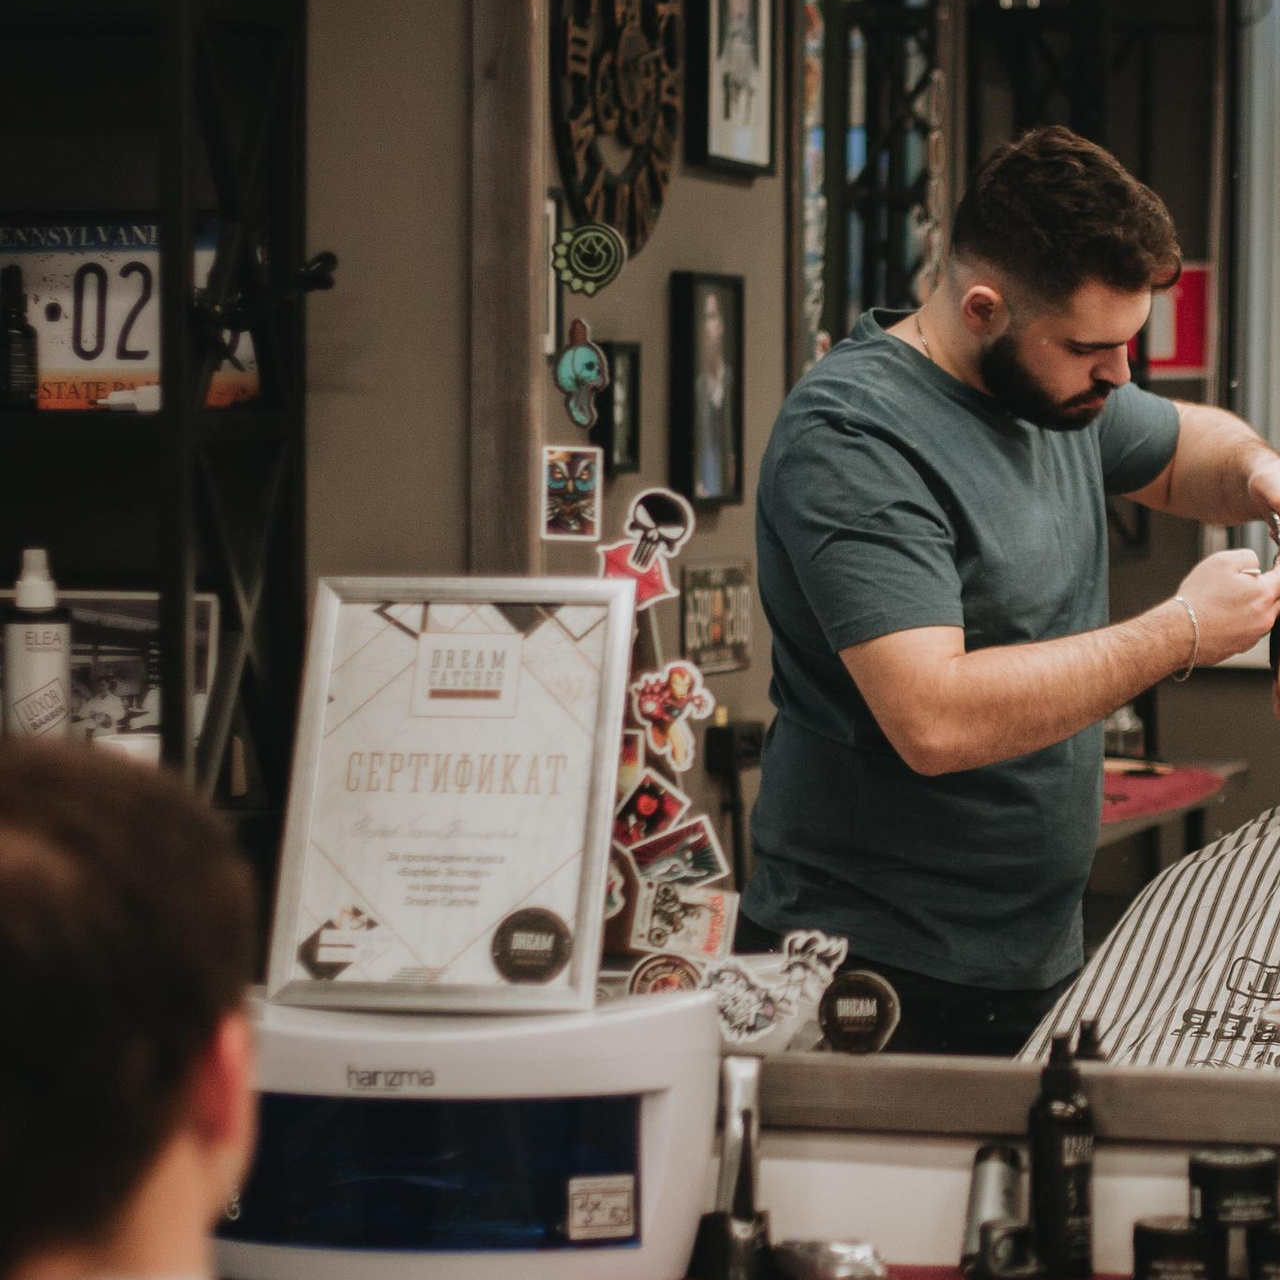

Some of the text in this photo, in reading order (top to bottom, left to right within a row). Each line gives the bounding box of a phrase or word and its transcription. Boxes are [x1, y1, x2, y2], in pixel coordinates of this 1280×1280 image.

[430, 648, 508, 670] DREAM
[428, 670, 505, 687] CATCHER
[344, 749, 570, 795] СЕРТИФИКАТ
